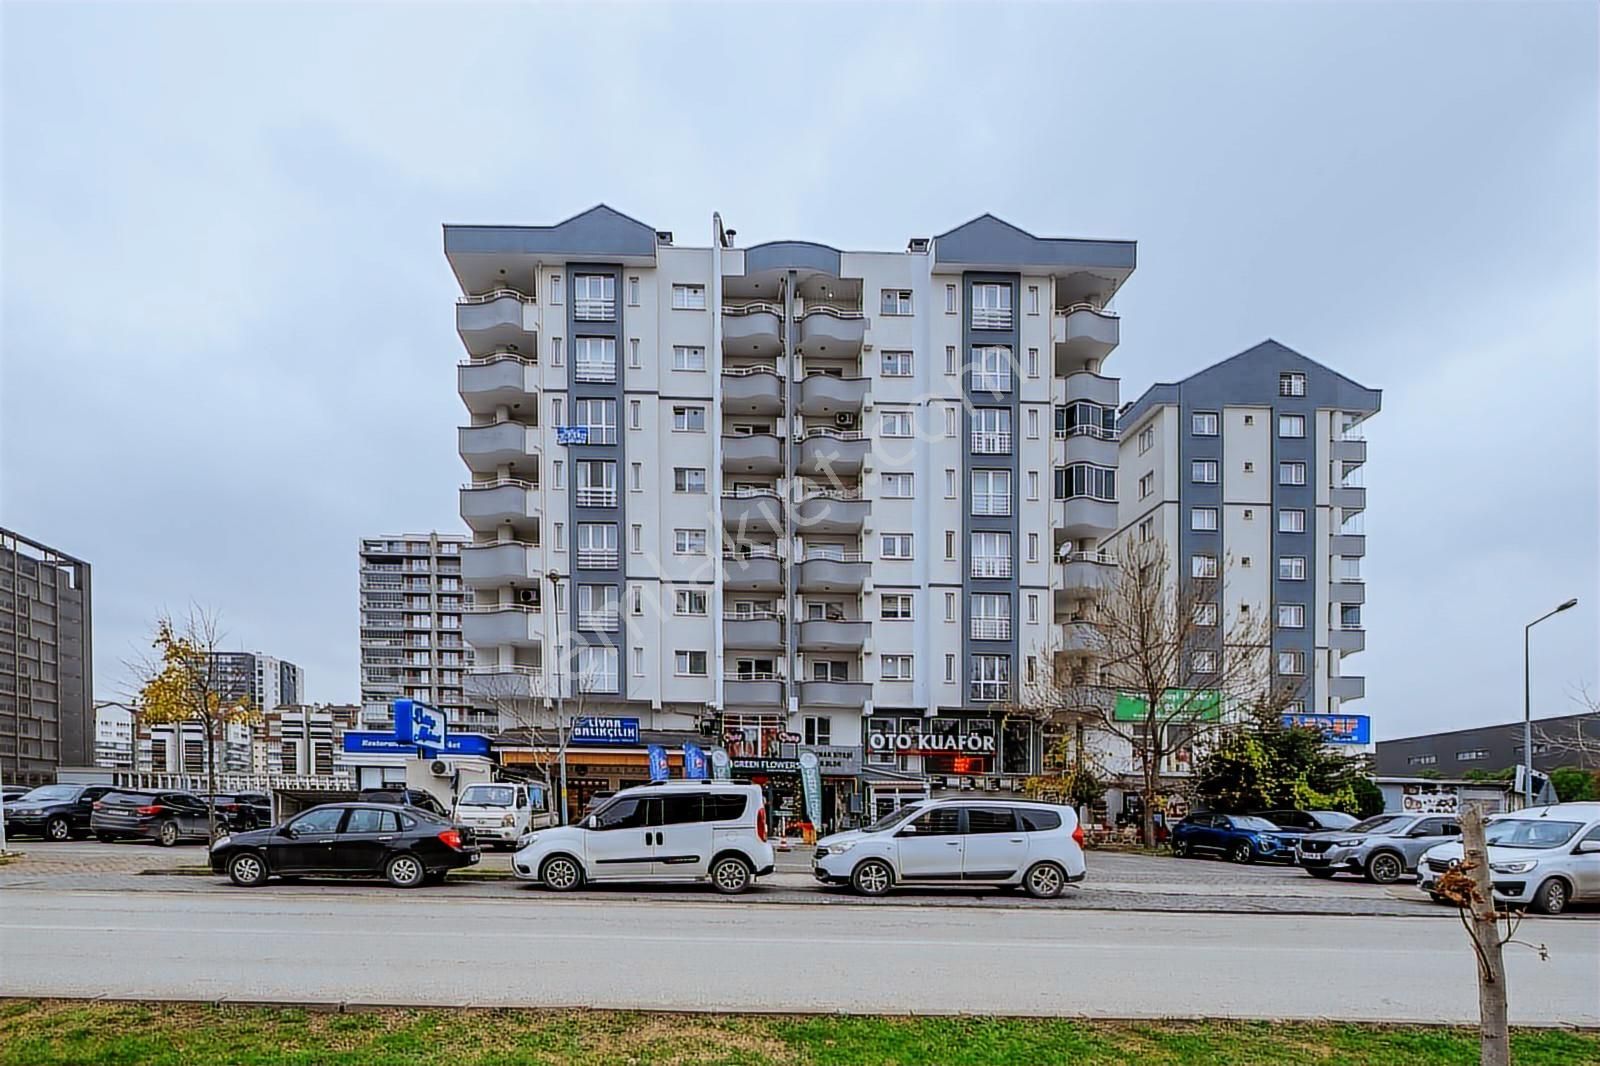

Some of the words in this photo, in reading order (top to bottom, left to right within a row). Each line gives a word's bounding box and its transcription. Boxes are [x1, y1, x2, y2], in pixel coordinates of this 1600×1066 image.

[869, 733, 911, 750] OTO
[918, 732, 995, 750] KUAFÖR
[734, 760, 759, 768] GREEN
[761, 760, 800, 769] FLOWERS
